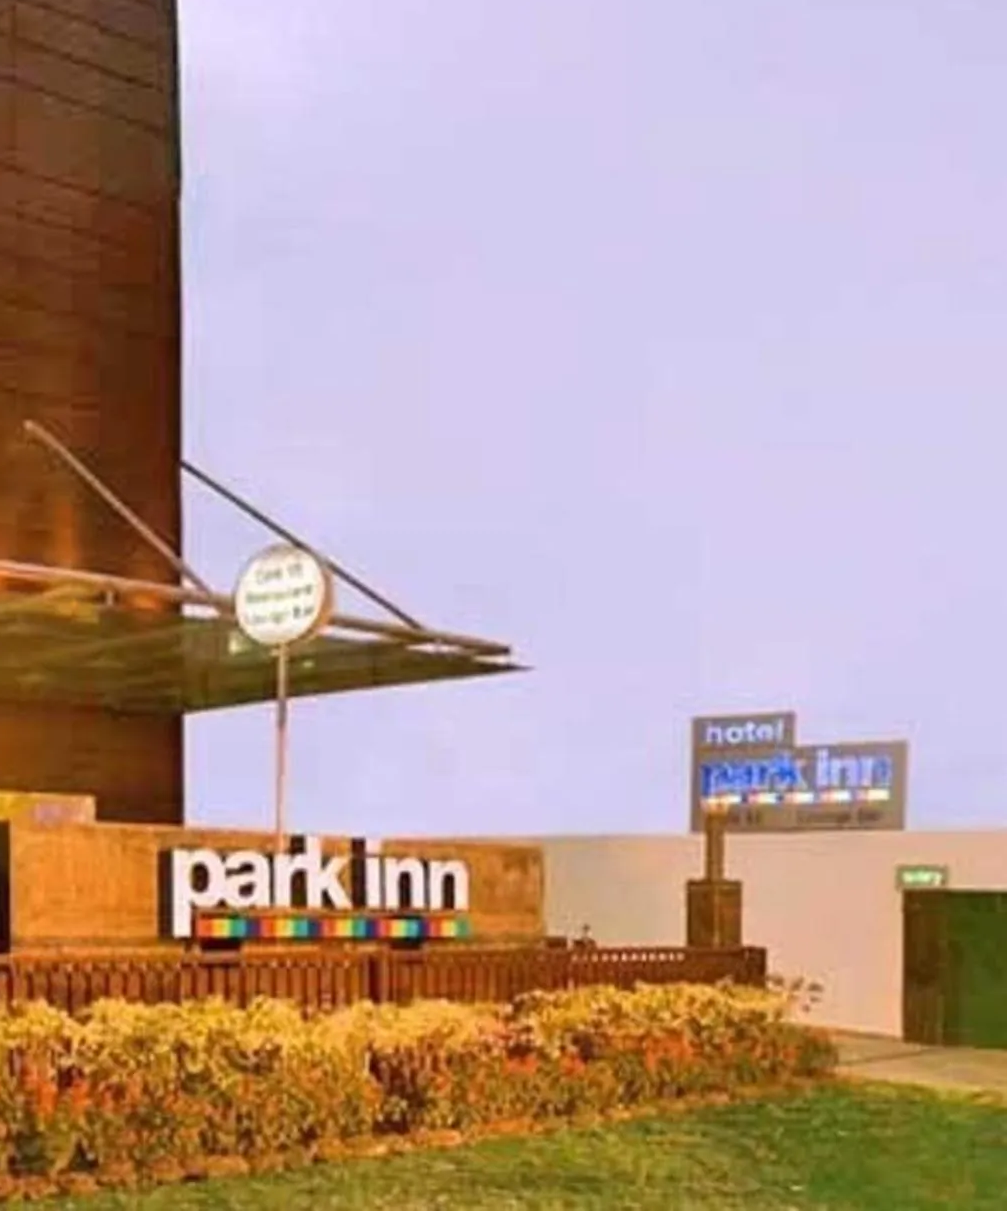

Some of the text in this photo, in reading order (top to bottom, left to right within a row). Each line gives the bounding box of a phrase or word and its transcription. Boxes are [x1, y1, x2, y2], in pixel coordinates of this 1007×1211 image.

[705, 719, 784, 743] hotel
[700, 748, 891, 797] park inn
[172, 836, 470, 937] park inn
